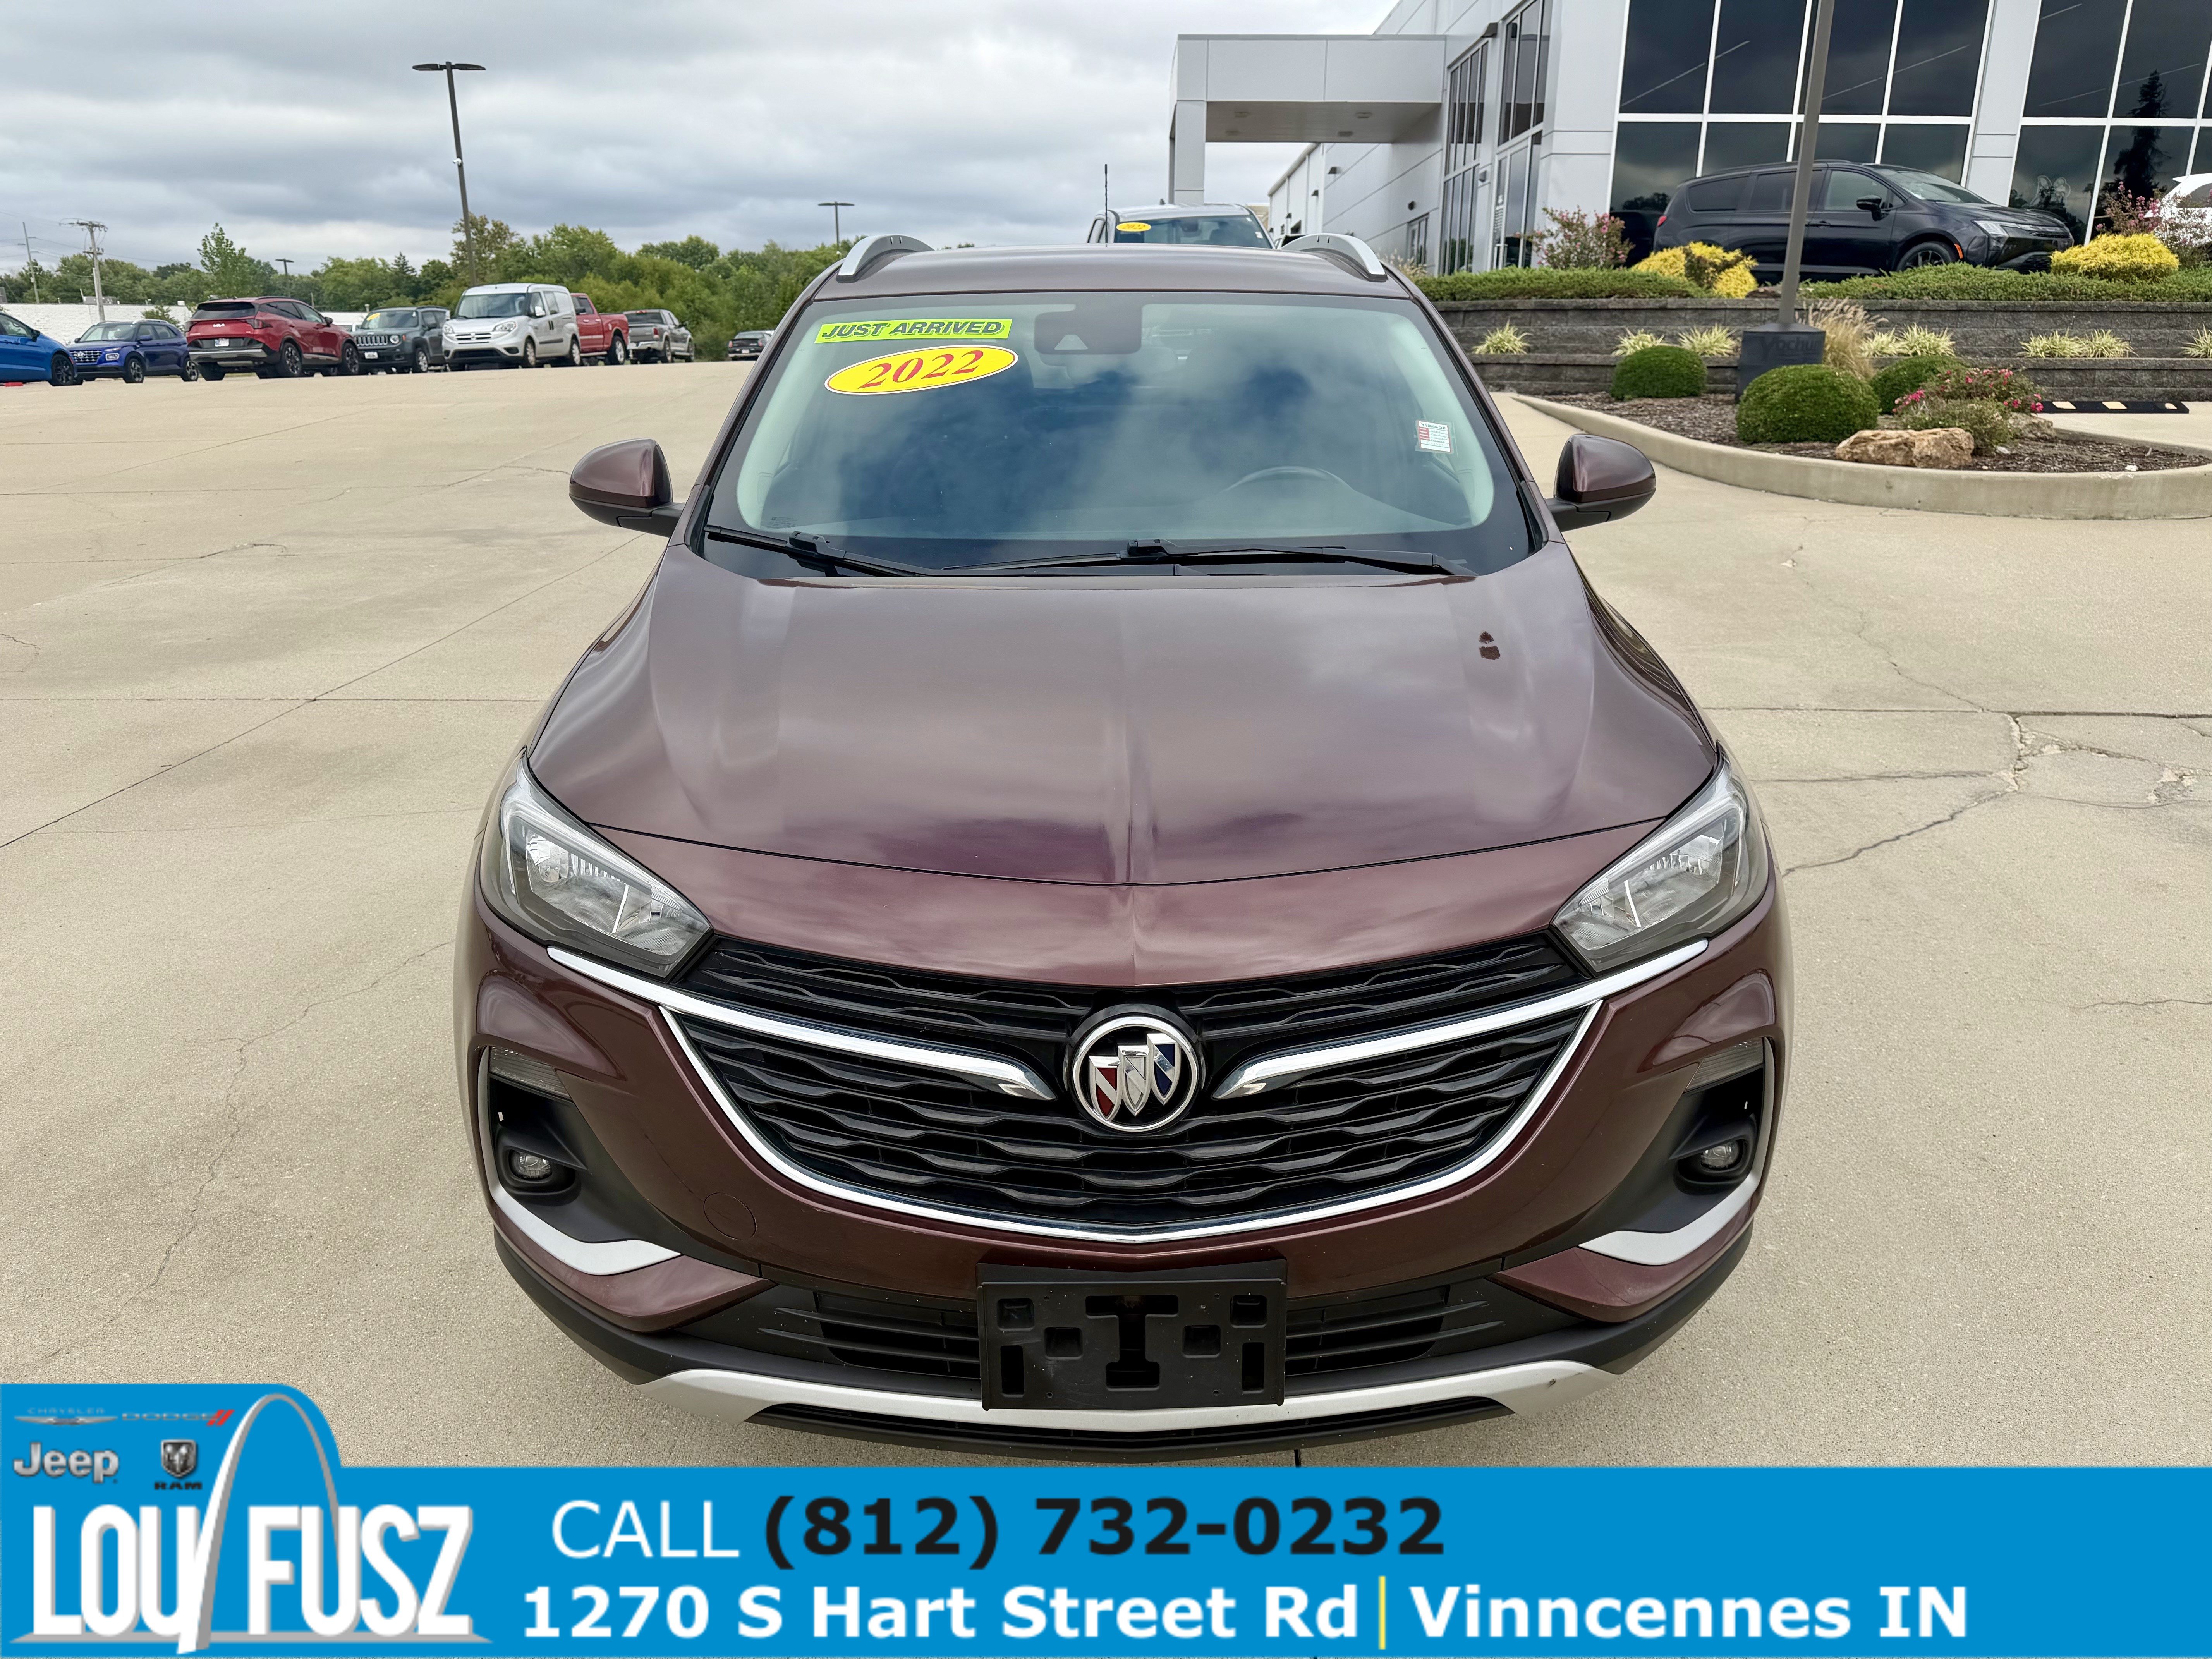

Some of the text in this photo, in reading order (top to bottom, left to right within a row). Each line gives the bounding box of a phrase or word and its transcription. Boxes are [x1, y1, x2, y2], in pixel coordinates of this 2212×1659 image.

[822, 321, 1005, 339] JUST ARRIVED
[857, 350, 984, 389] 2022
